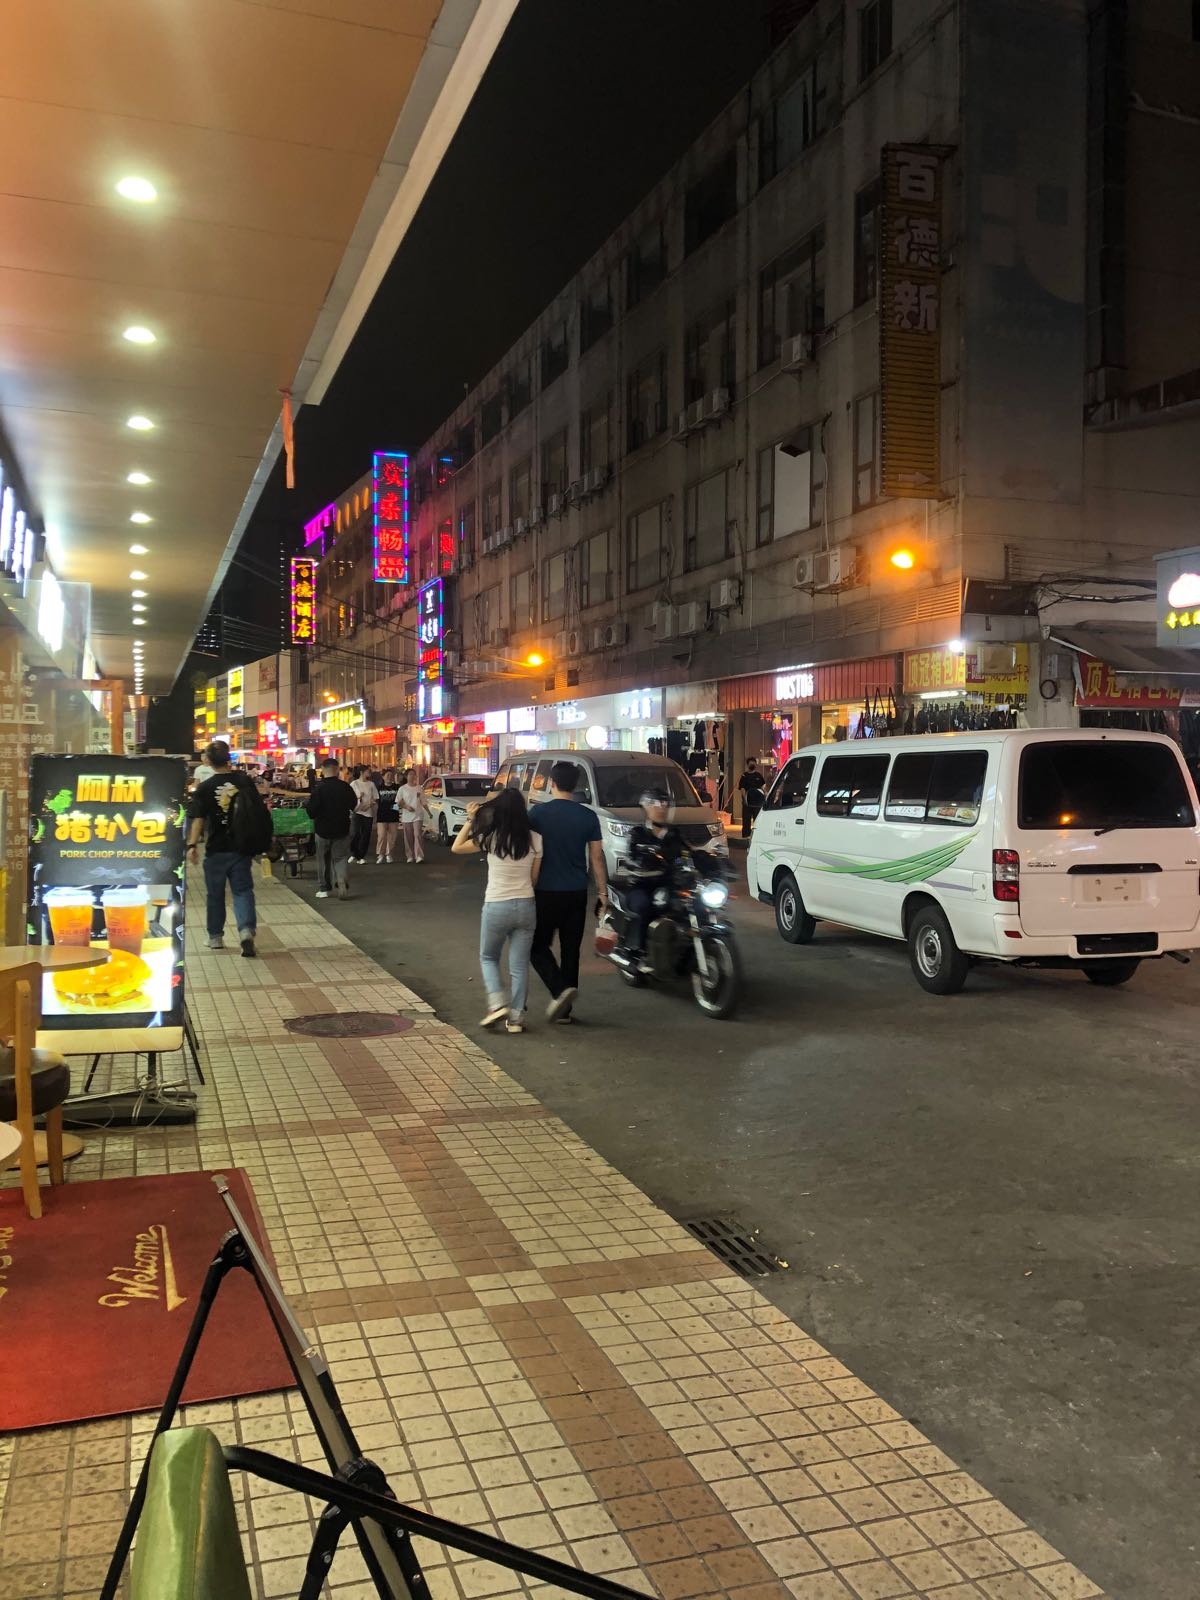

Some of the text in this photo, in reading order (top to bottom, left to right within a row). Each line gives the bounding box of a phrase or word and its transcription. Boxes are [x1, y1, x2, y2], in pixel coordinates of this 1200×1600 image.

[894, 150, 940, 333] 百德新
[376, 567, 405, 579] KTV
[75, 774, 146, 803] 阿叔
[54, 810, 167, 844] 猪扒包
[60, 850, 161, 859] PORK CHOP PACKAGE
[98, 1224, 187, 1311] Welcome
